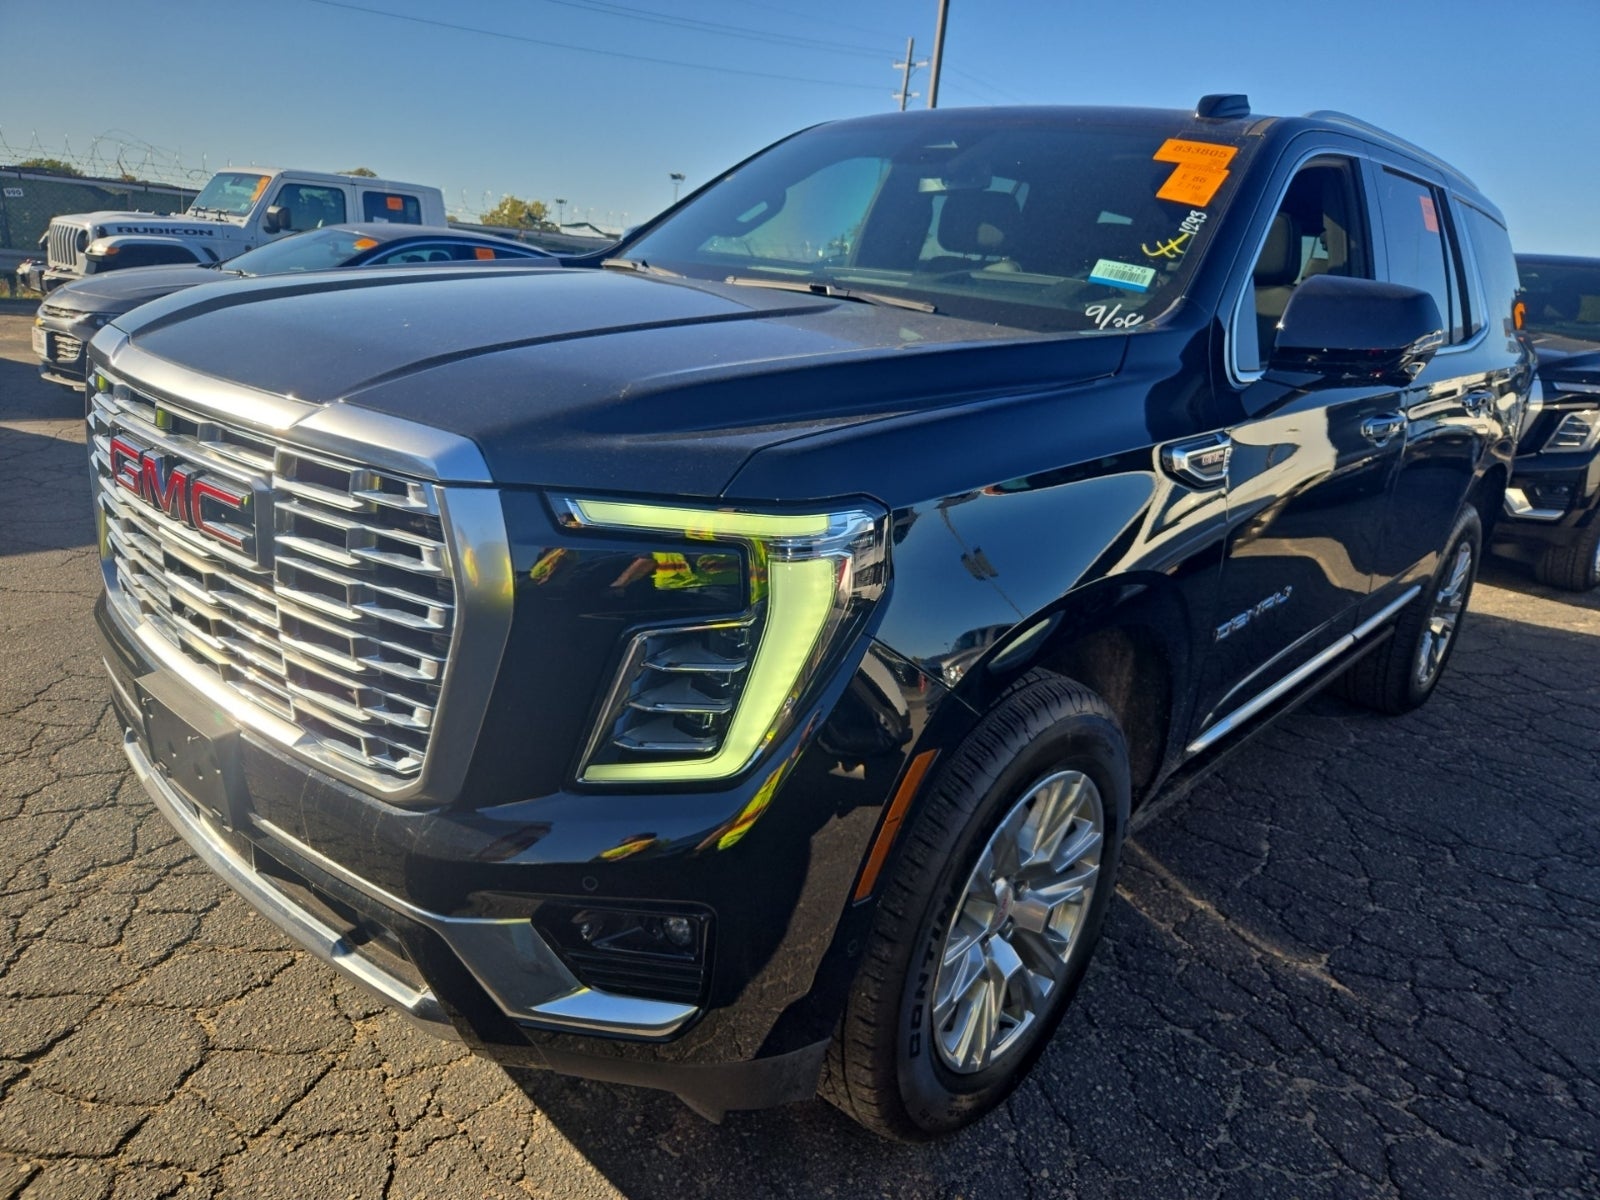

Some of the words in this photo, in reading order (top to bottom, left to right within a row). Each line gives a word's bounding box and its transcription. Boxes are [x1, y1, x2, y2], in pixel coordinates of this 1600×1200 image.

[116, 226, 214, 237] RUBICON
[1179, 210, 1207, 235] 1293
[109, 435, 249, 550] GMC
[1214, 585, 1294, 641] DENALI
